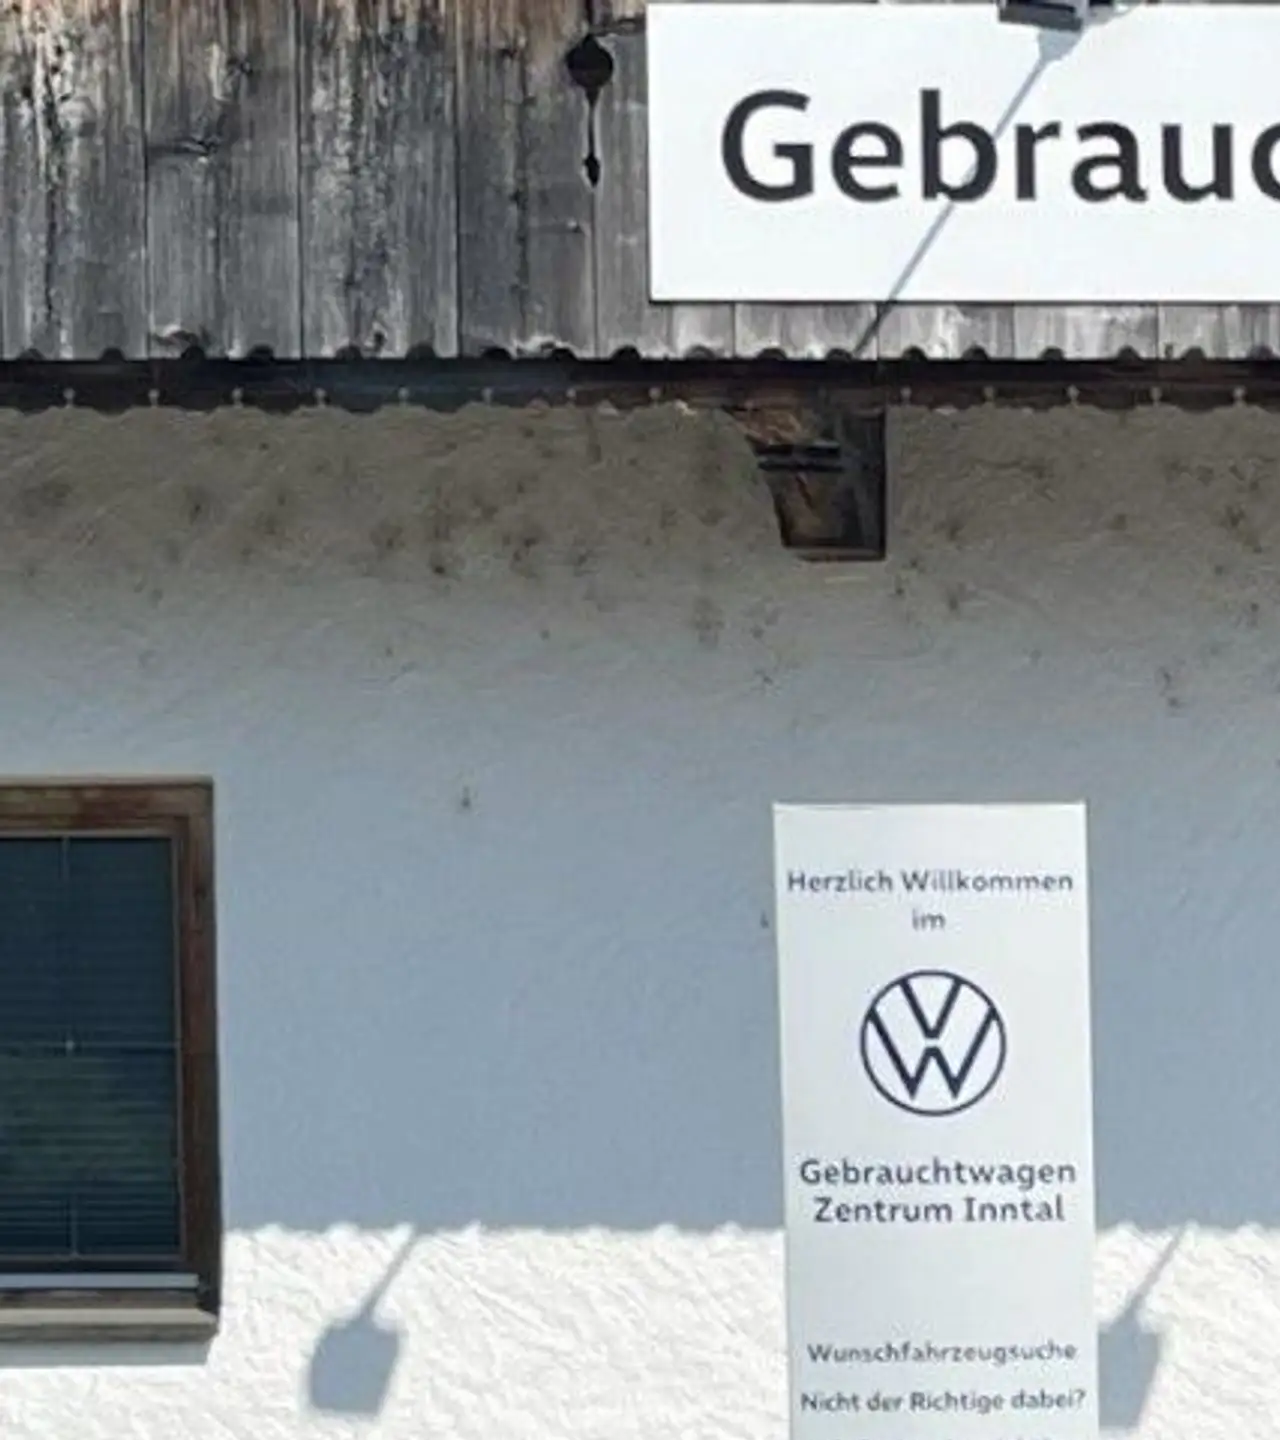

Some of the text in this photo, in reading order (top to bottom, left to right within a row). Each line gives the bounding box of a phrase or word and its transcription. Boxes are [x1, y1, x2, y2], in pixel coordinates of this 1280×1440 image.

[786, 867, 1074, 893] Herzlich Willkommen
[911, 908, 946, 931] im
[860, 969, 1007, 1117] VW
[799, 1157, 1078, 1191] Gebrauchtwagen
[812, 1194, 1066, 1224] Zentrum Inntal
[806, 1339, 1079, 1366] Wunschfahrzeugsuche
[800, 1388, 1088, 1416] Nicht der Richtige dabei?
